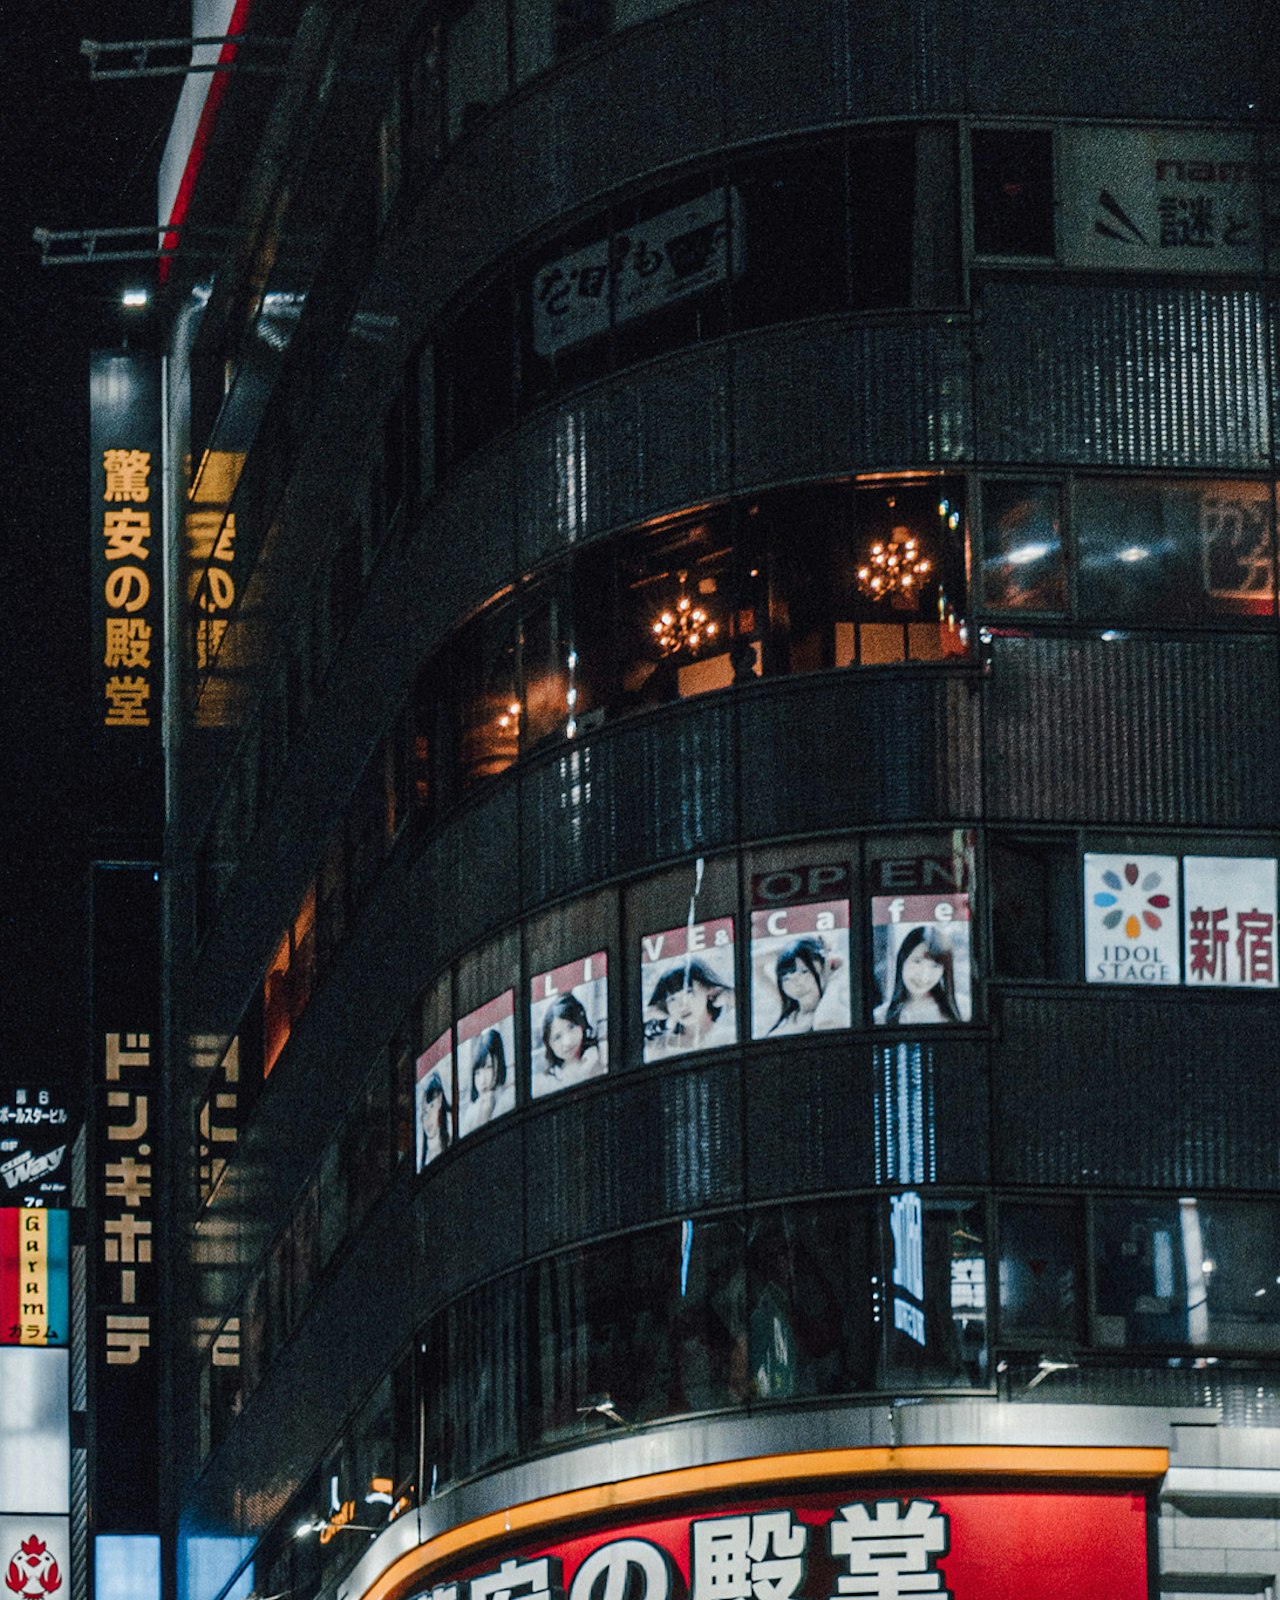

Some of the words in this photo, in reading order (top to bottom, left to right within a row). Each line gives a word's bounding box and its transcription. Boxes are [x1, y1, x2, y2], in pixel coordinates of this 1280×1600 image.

[103, 449, 152, 727] 驚安の殿堂
[1102, 945, 1165, 963] IDOL
[1189, 906, 1274, 983] 新宿
[1096, 964, 1171, 981] STAGE
[23, 1215, 45, 1315] Garam
[8, 1324, 59, 1340] ガラム
